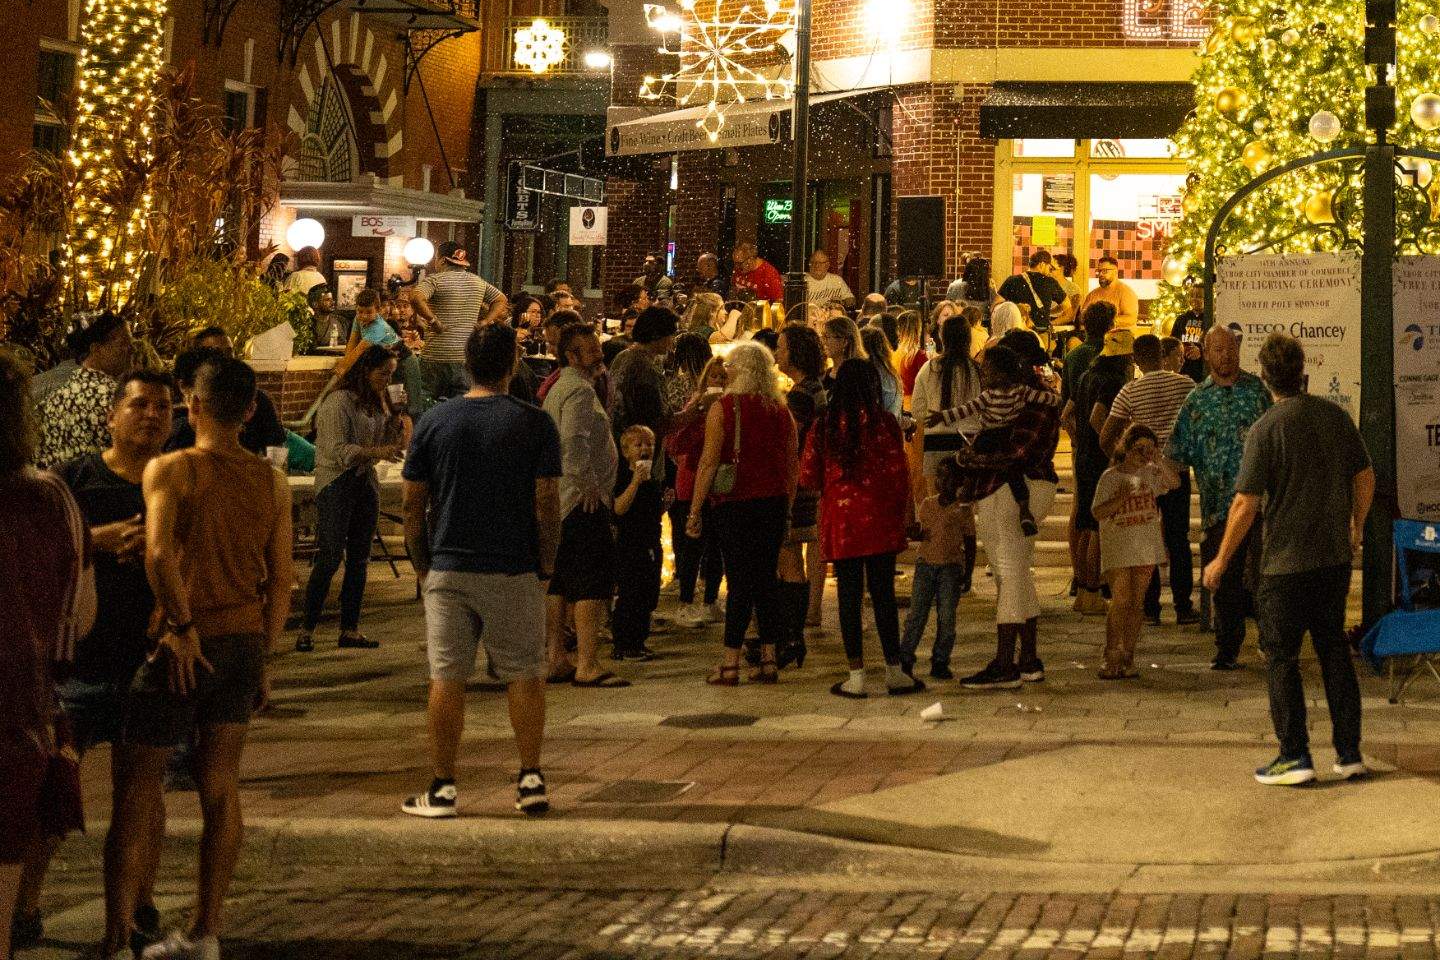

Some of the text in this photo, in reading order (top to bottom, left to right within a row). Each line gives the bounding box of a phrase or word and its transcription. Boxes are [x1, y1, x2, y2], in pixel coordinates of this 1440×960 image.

[1224, 277, 1352, 290] TREE LIGHTING CEREMONY
[1241, 299, 1331, 310] NORTH POLE SPONSOR
[1245, 322, 1347, 341] TECO Chancey
